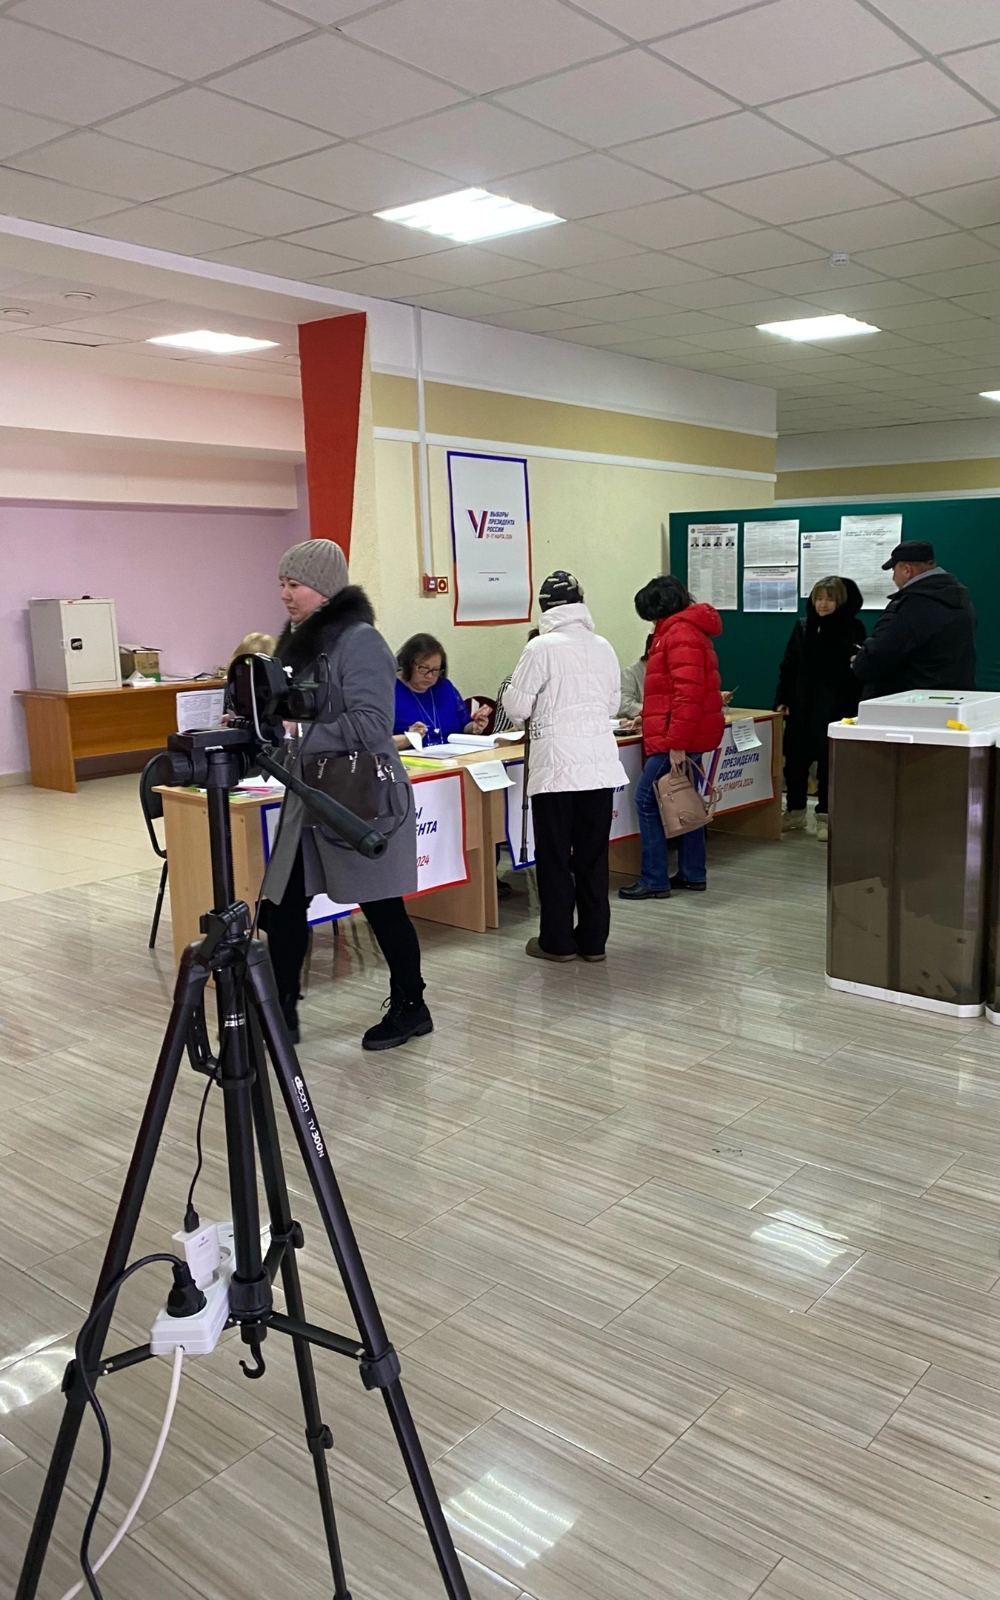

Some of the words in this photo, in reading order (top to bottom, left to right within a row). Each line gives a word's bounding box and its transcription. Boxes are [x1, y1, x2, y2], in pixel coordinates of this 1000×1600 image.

[488, 518, 515, 526] ПРЕЗИДЕНТА
[721, 753, 760, 769] ПРЕЗИДЕНТА
[718, 769, 743, 782] РОССИИ
[416, 855, 430, 868] 024
